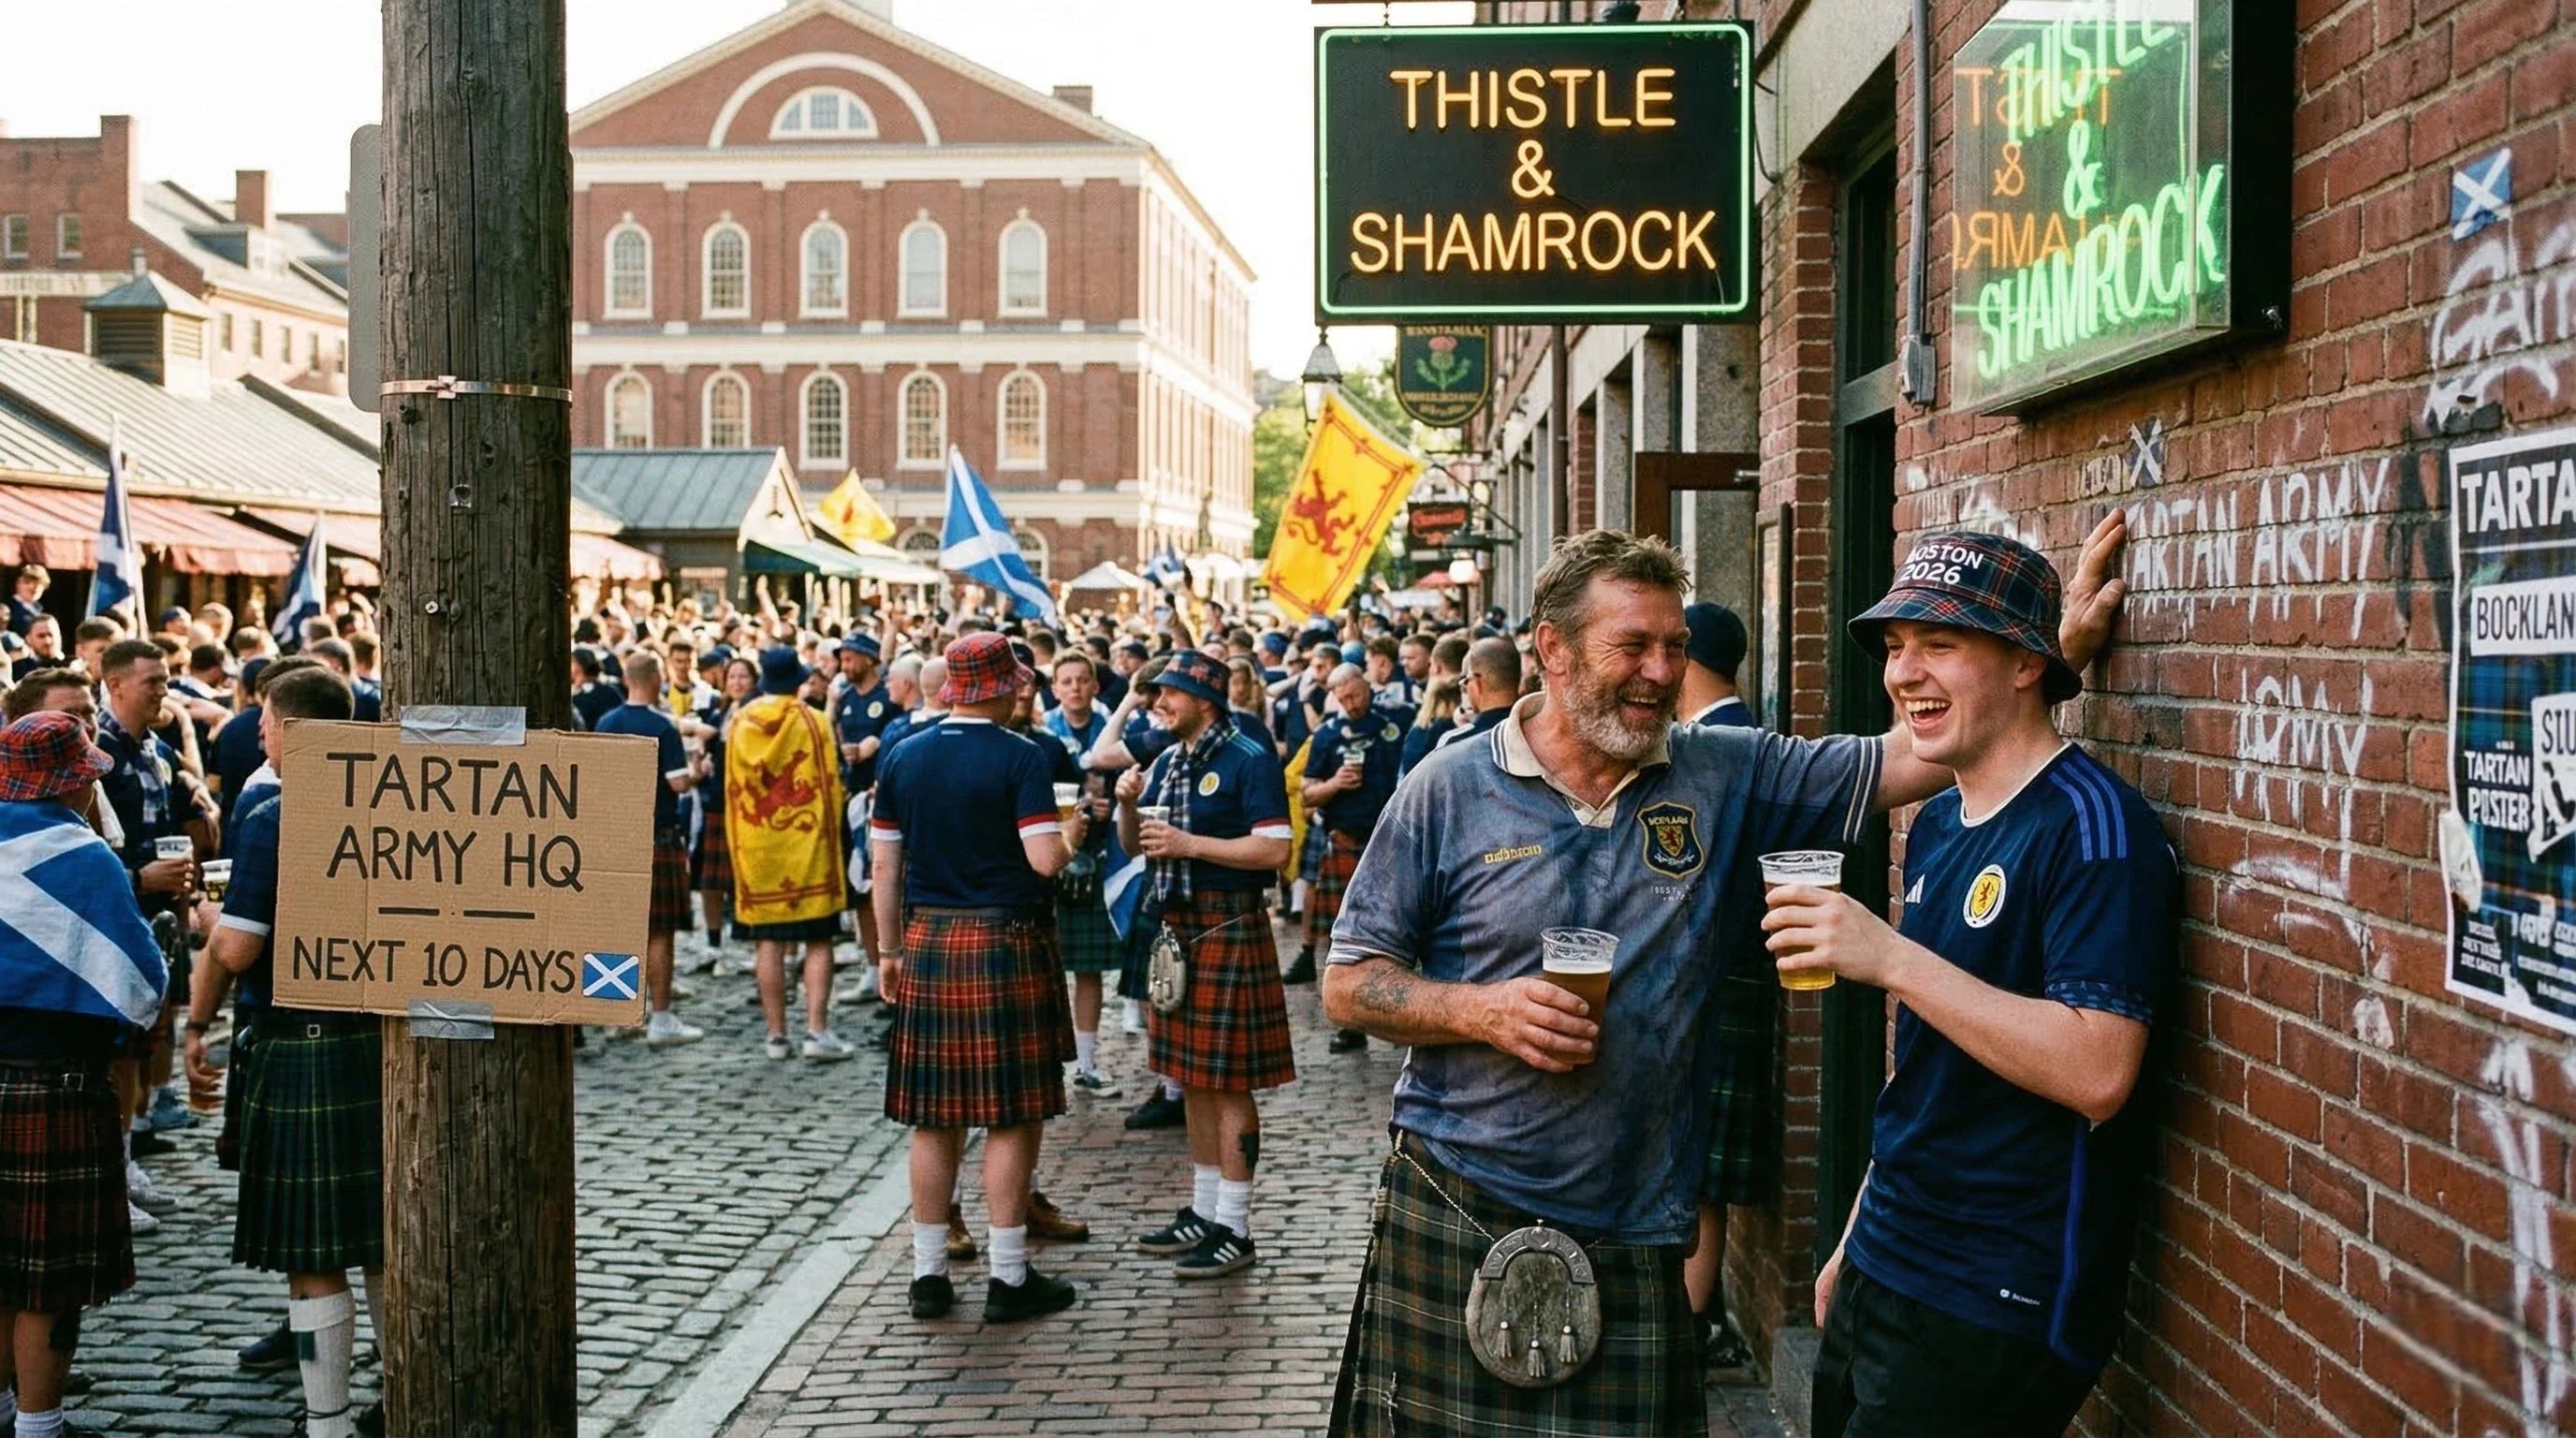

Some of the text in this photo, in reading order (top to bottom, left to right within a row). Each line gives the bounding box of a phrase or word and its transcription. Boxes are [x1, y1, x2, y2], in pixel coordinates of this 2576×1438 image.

[1390, 67, 1676, 129] THISTLE
[1511, 139, 1555, 198] &
[2062, 119, 2102, 220] &
[1350, 210, 1718, 272] SHAMROCK
[1977, 164, 2226, 378] SHAMROCK
[2460, 458, 2576, 534] TARTA
[1898, 562, 1963, 585] 2026
[2248, 458, 2391, 640] ARMY
[326, 752, 578, 820] TARTAN
[2464, 750, 2530, 786] TARTAN
[326, 825, 584, 892] ARMY HQ
[292, 936, 576, 993] NEXT 10 DAYS
